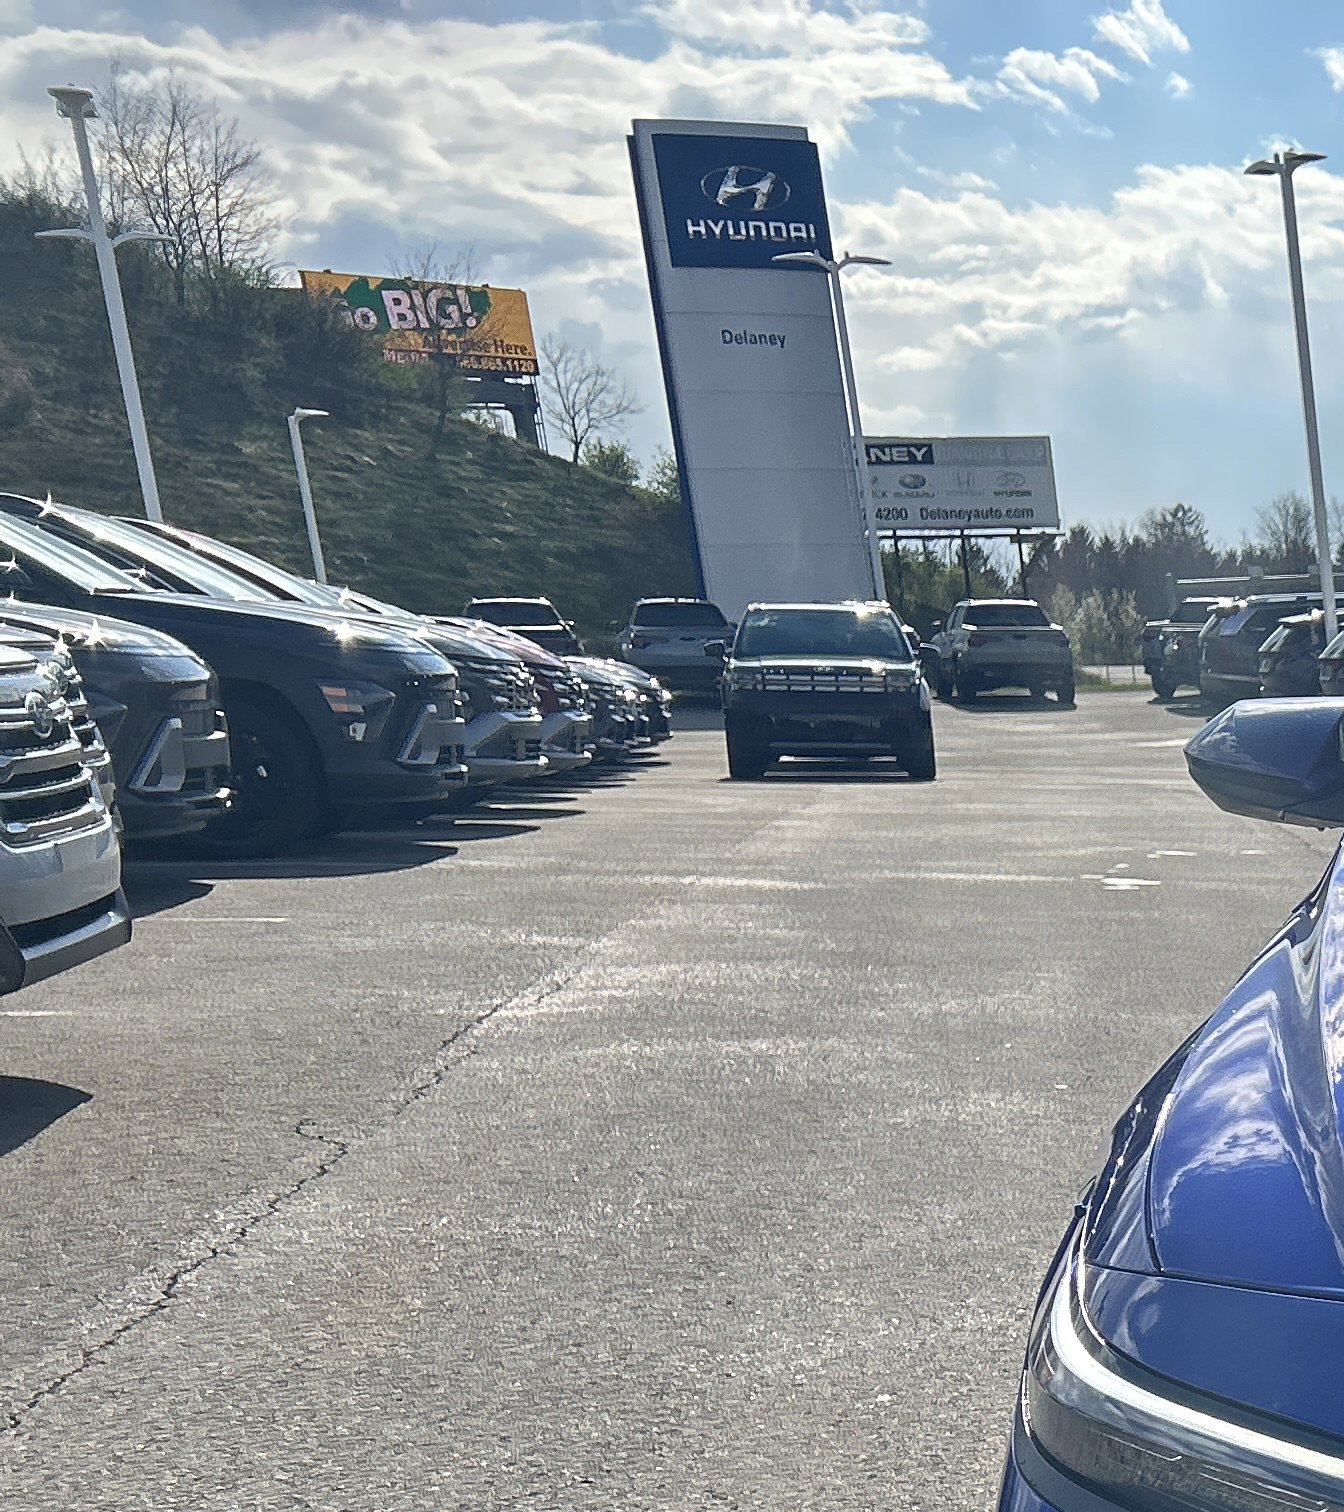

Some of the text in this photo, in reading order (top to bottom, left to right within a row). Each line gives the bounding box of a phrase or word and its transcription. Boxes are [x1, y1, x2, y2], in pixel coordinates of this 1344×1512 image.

[686, 218, 816, 243] HYUNDAI
[381, 288, 478, 331] BIG!
[493, 337, 532, 357] Here.
[720, 329, 786, 349] Delaney
[868, 447, 929, 463] NEY
[919, 507, 1034, 523] Delaneyauto.com
